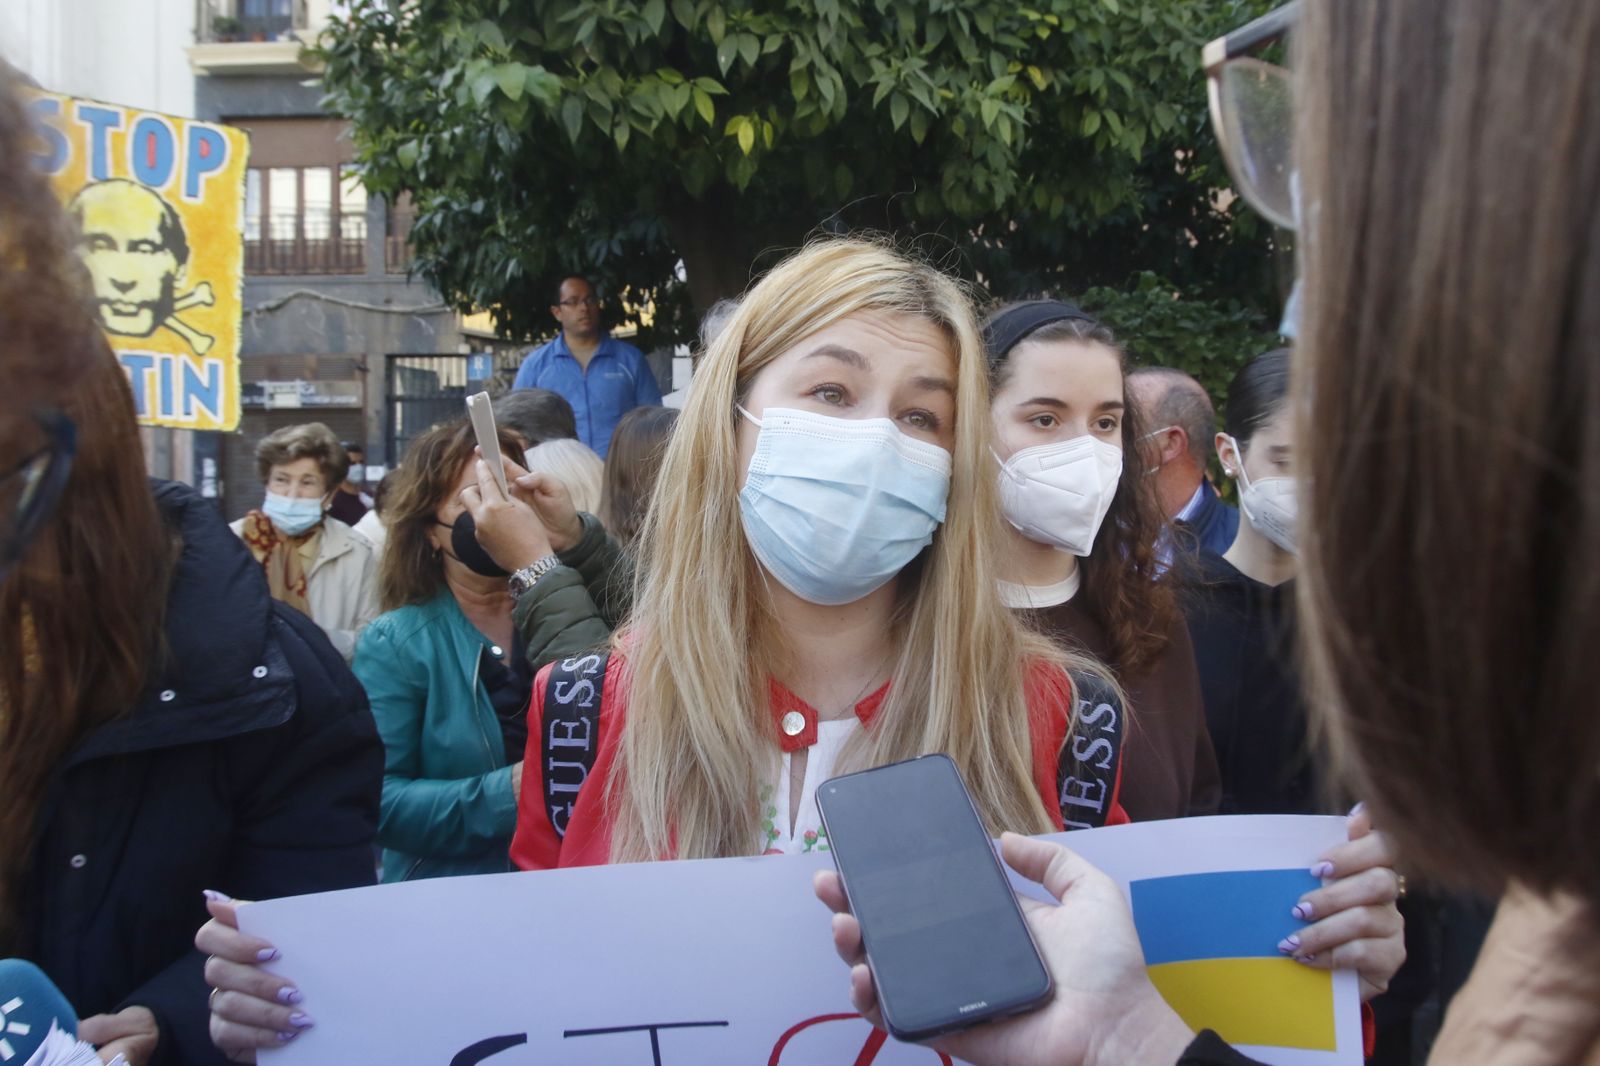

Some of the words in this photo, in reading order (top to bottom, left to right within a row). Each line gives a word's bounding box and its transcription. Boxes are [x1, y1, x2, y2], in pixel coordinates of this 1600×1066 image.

[28, 97, 229, 202] STOP
[114, 350, 224, 423] TIN
[1060, 699, 1117, 830] ESS
[959, 1000, 988, 1014] NOKIA
